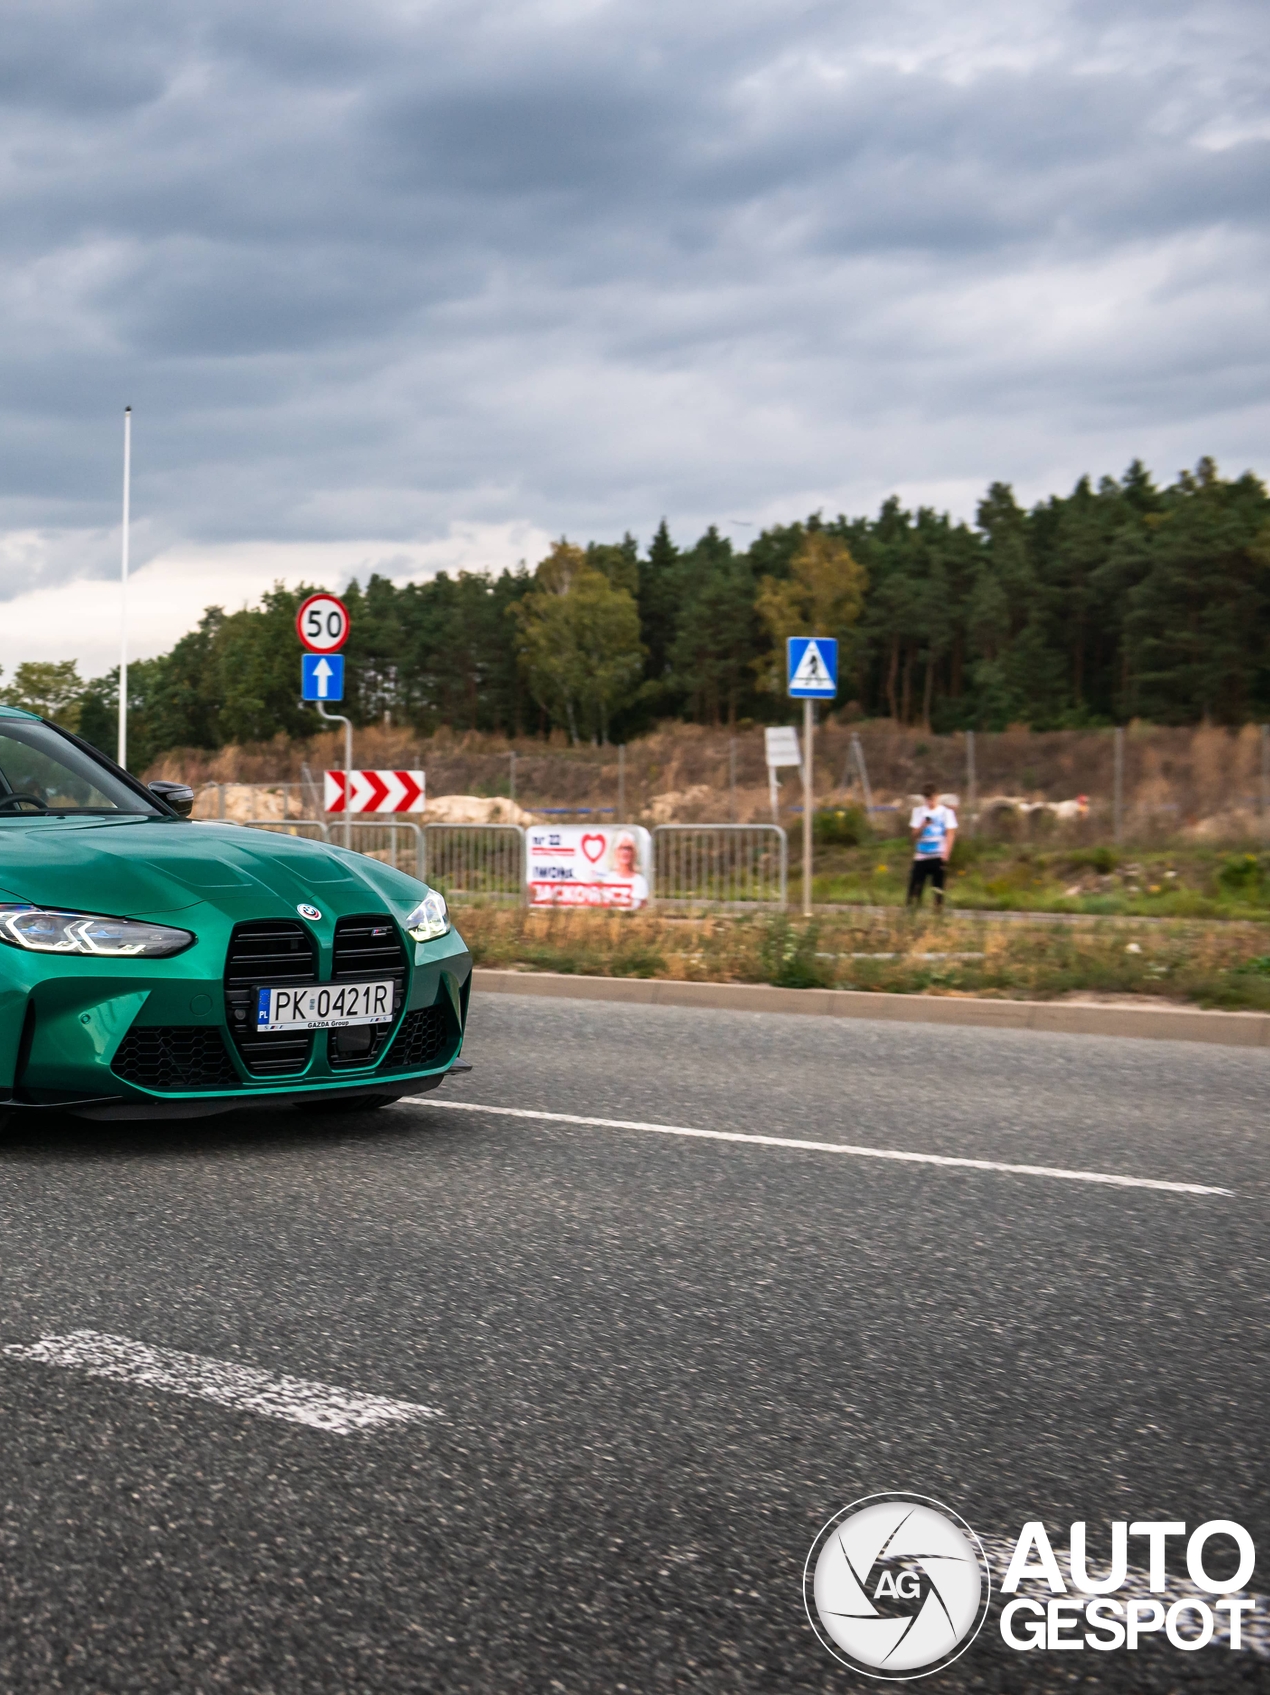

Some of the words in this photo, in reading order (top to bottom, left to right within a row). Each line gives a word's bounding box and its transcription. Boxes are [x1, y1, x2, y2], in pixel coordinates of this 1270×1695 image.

[307, 610, 342, 638] 50
[259, 1011, 268, 1019] PL
[275, 991, 308, 1021] PK
[317, 985, 387, 1018] 0421R
